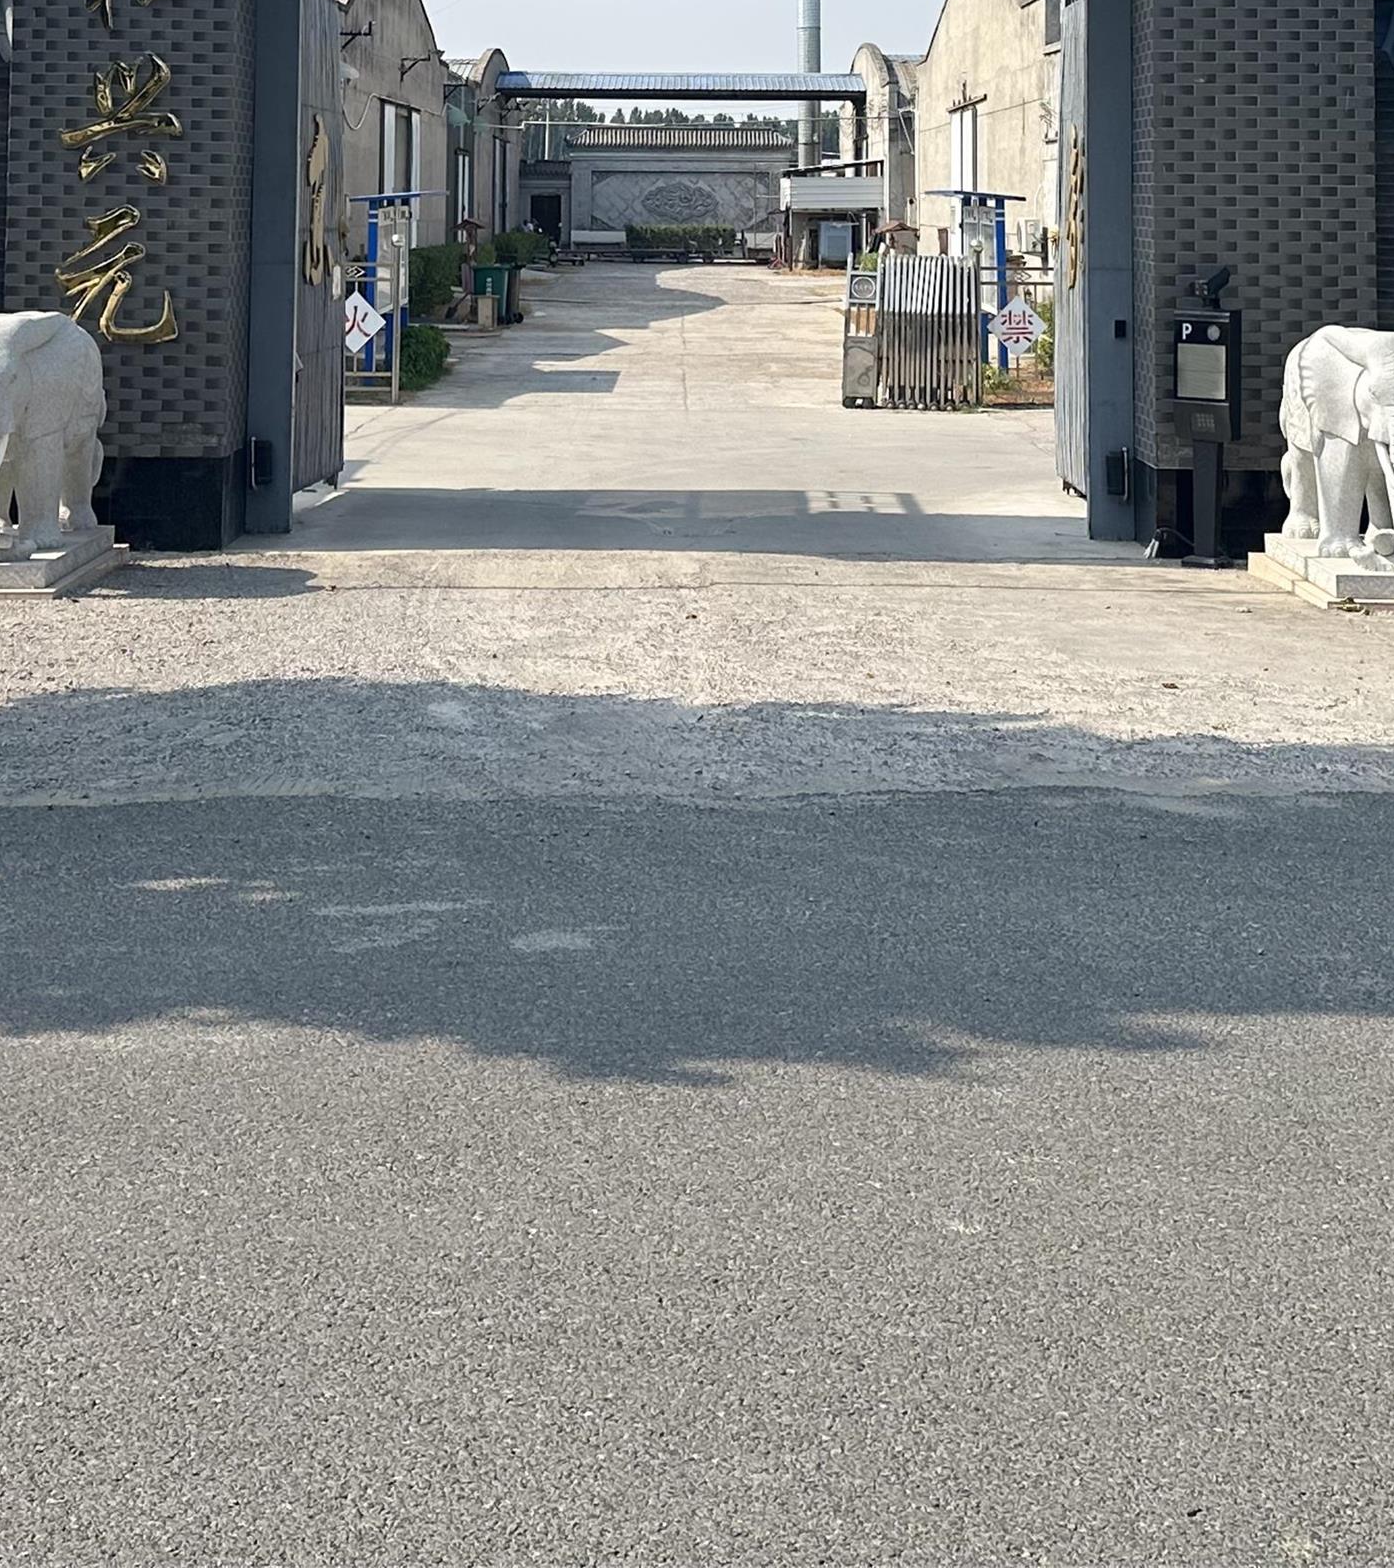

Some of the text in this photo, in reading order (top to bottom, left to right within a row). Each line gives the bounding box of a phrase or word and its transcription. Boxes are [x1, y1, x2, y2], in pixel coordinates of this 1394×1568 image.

[345, 305, 371, 337] 火
[1000, 309, 1034, 344] 禁
[1181, 322, 1193, 341] P
